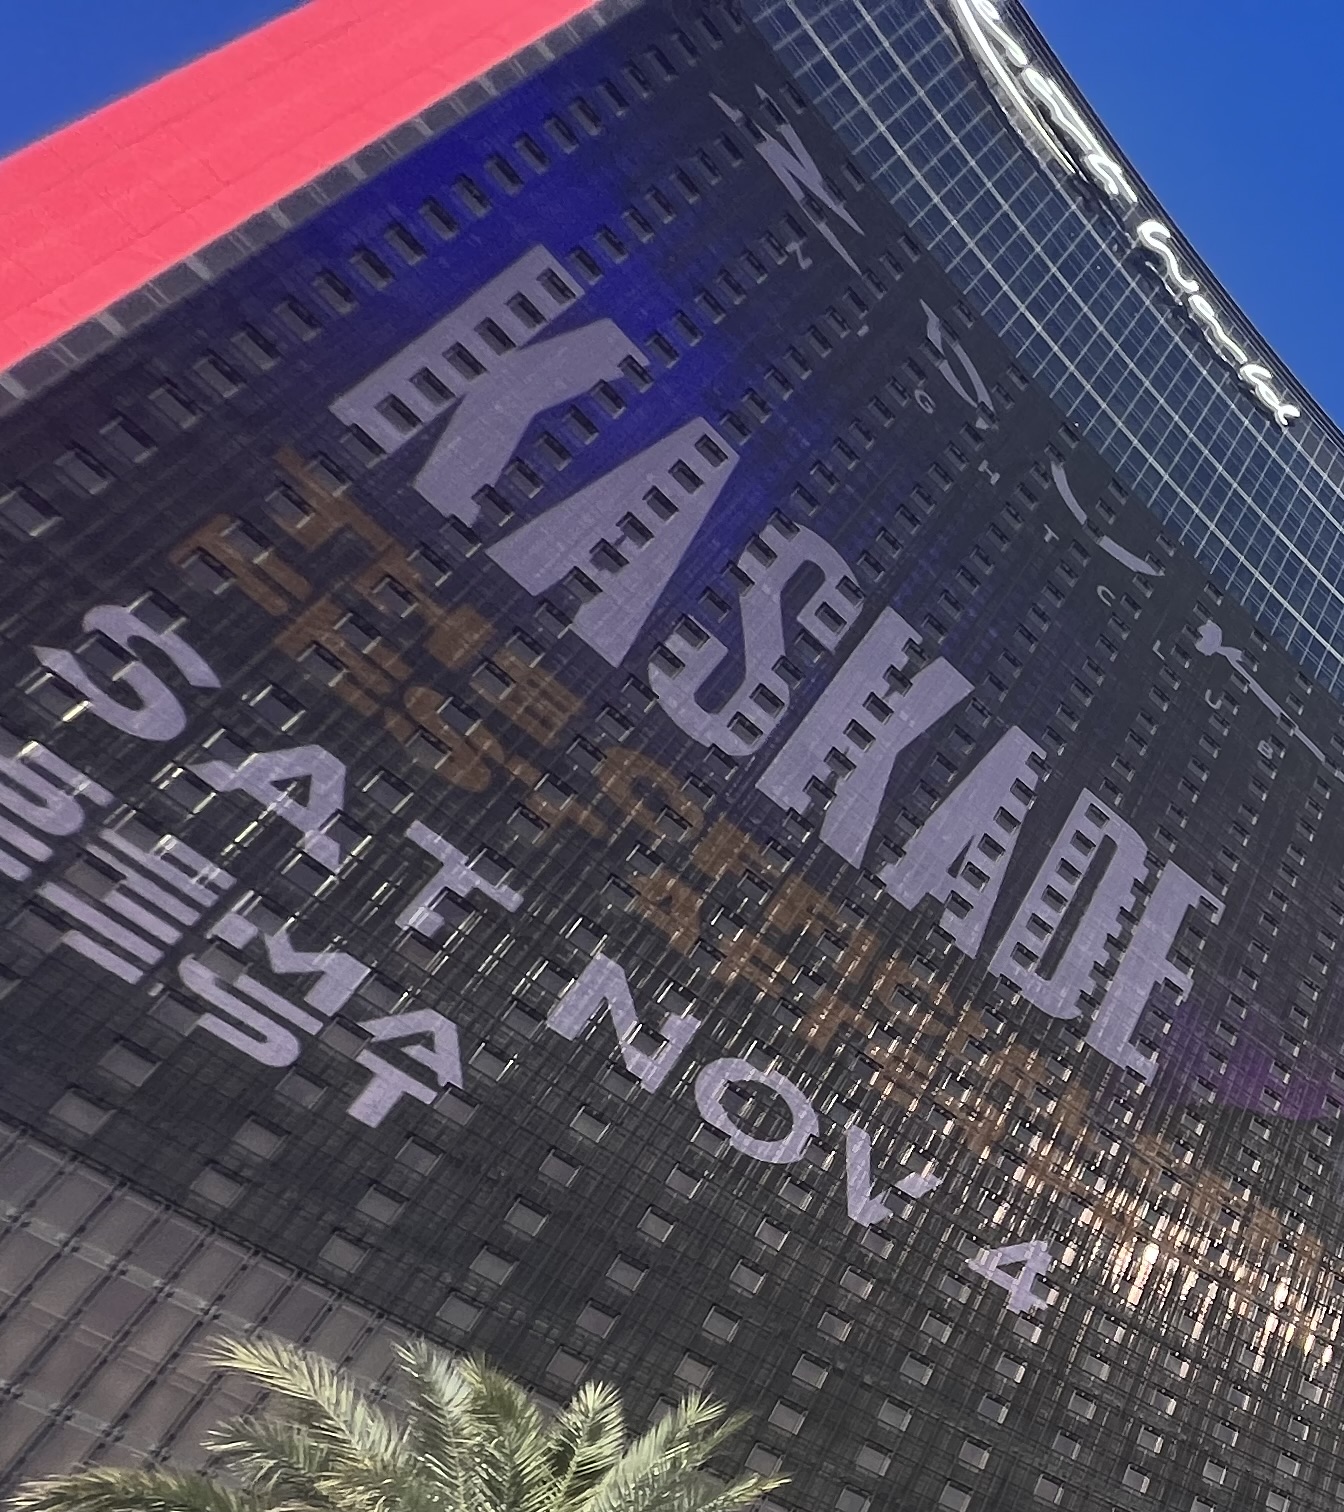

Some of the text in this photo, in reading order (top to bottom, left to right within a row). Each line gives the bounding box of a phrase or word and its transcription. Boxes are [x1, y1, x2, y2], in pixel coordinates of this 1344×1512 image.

[169, 512, 607, 845] FEST
[272, 444, 585, 747] THE
[329, 245, 1226, 1087] KASKADE
[786, 242, 1274, 758] NIGHTCLUB
[33, 603, 1057, 1315] SAT NOV 4
